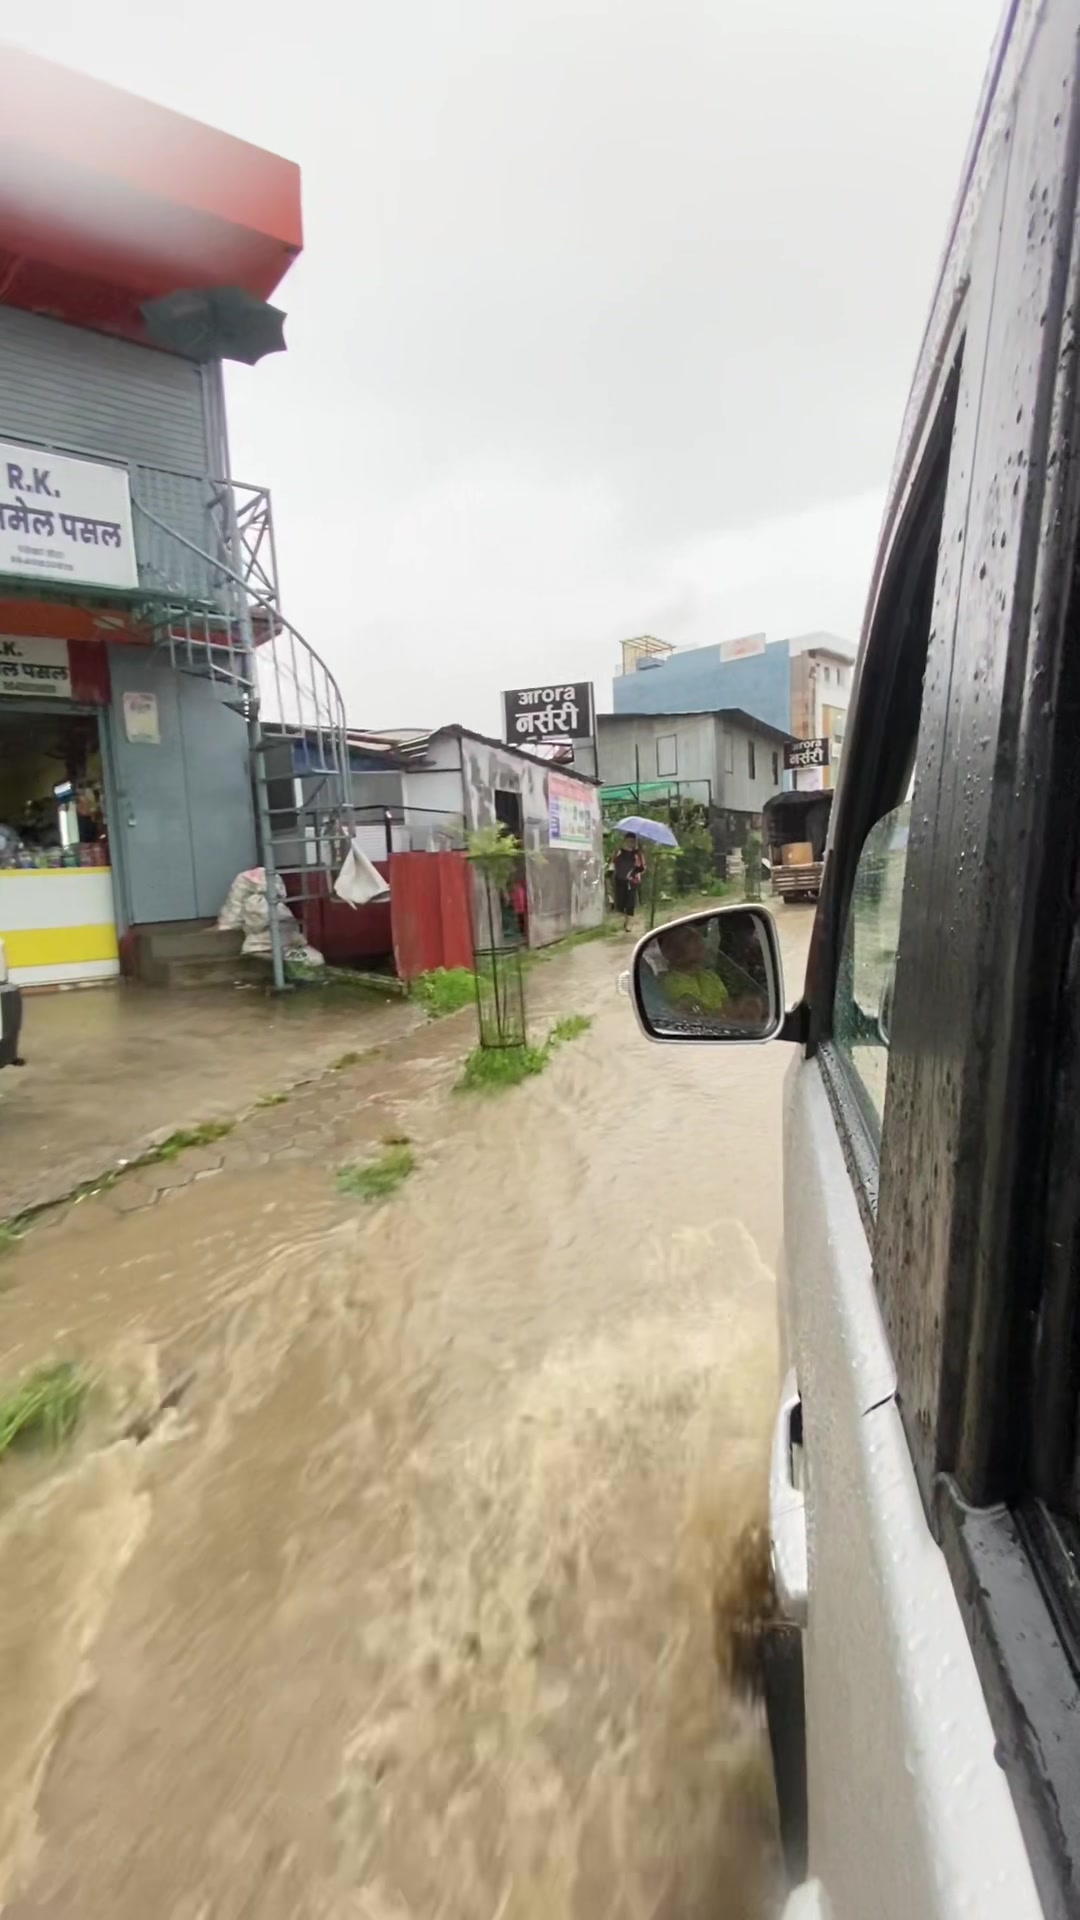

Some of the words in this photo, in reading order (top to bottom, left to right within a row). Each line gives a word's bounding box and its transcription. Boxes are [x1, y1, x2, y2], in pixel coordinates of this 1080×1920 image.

[6, 462, 61, 498] R.K.
[58, 512, 122, 548] पसल
[515, 701, 579, 733] नर्सरी
